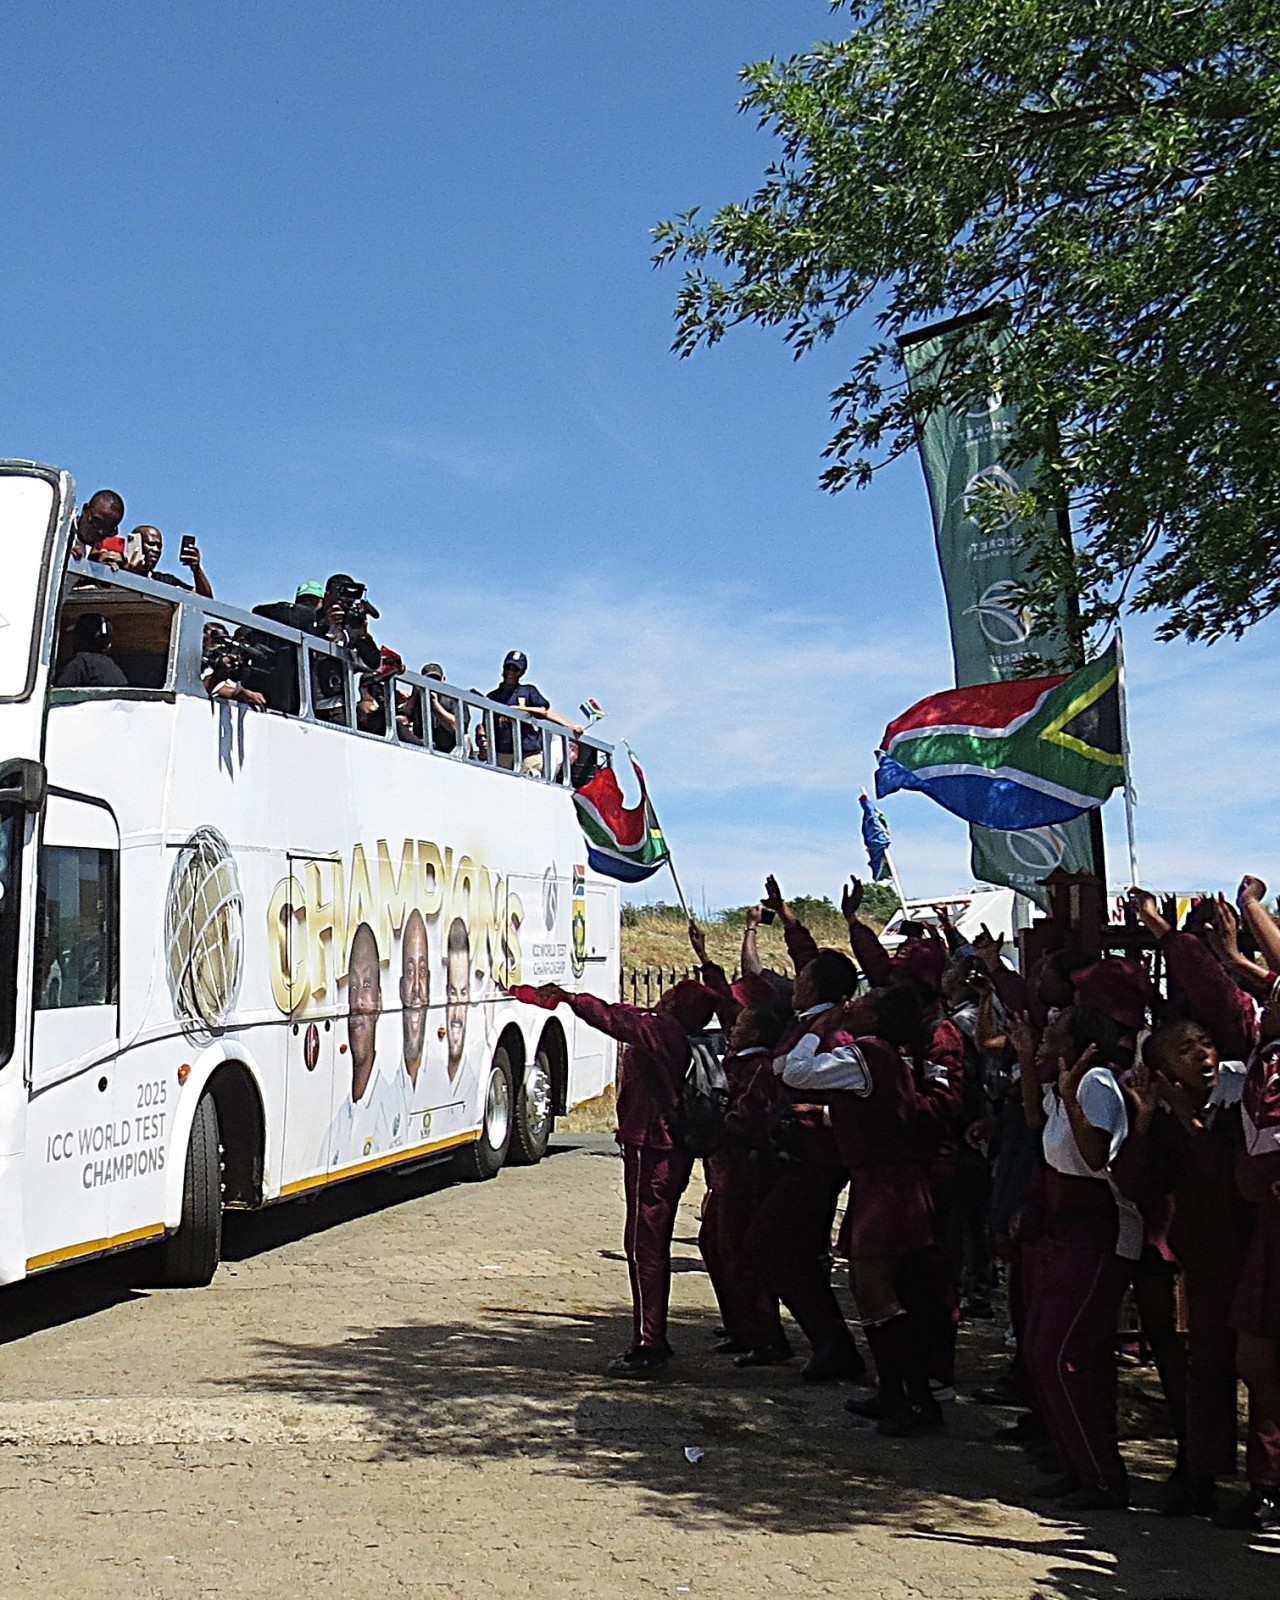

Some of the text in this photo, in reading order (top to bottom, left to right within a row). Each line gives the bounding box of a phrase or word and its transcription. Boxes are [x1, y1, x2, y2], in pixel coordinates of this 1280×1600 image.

[267, 838, 524, 1015] CHAMPIONS
[137, 1080, 167, 1109] 2025
[47, 1112, 166, 1163] ICC WORLD TEST
[83, 1145, 165, 1189] CHAMPIONS
